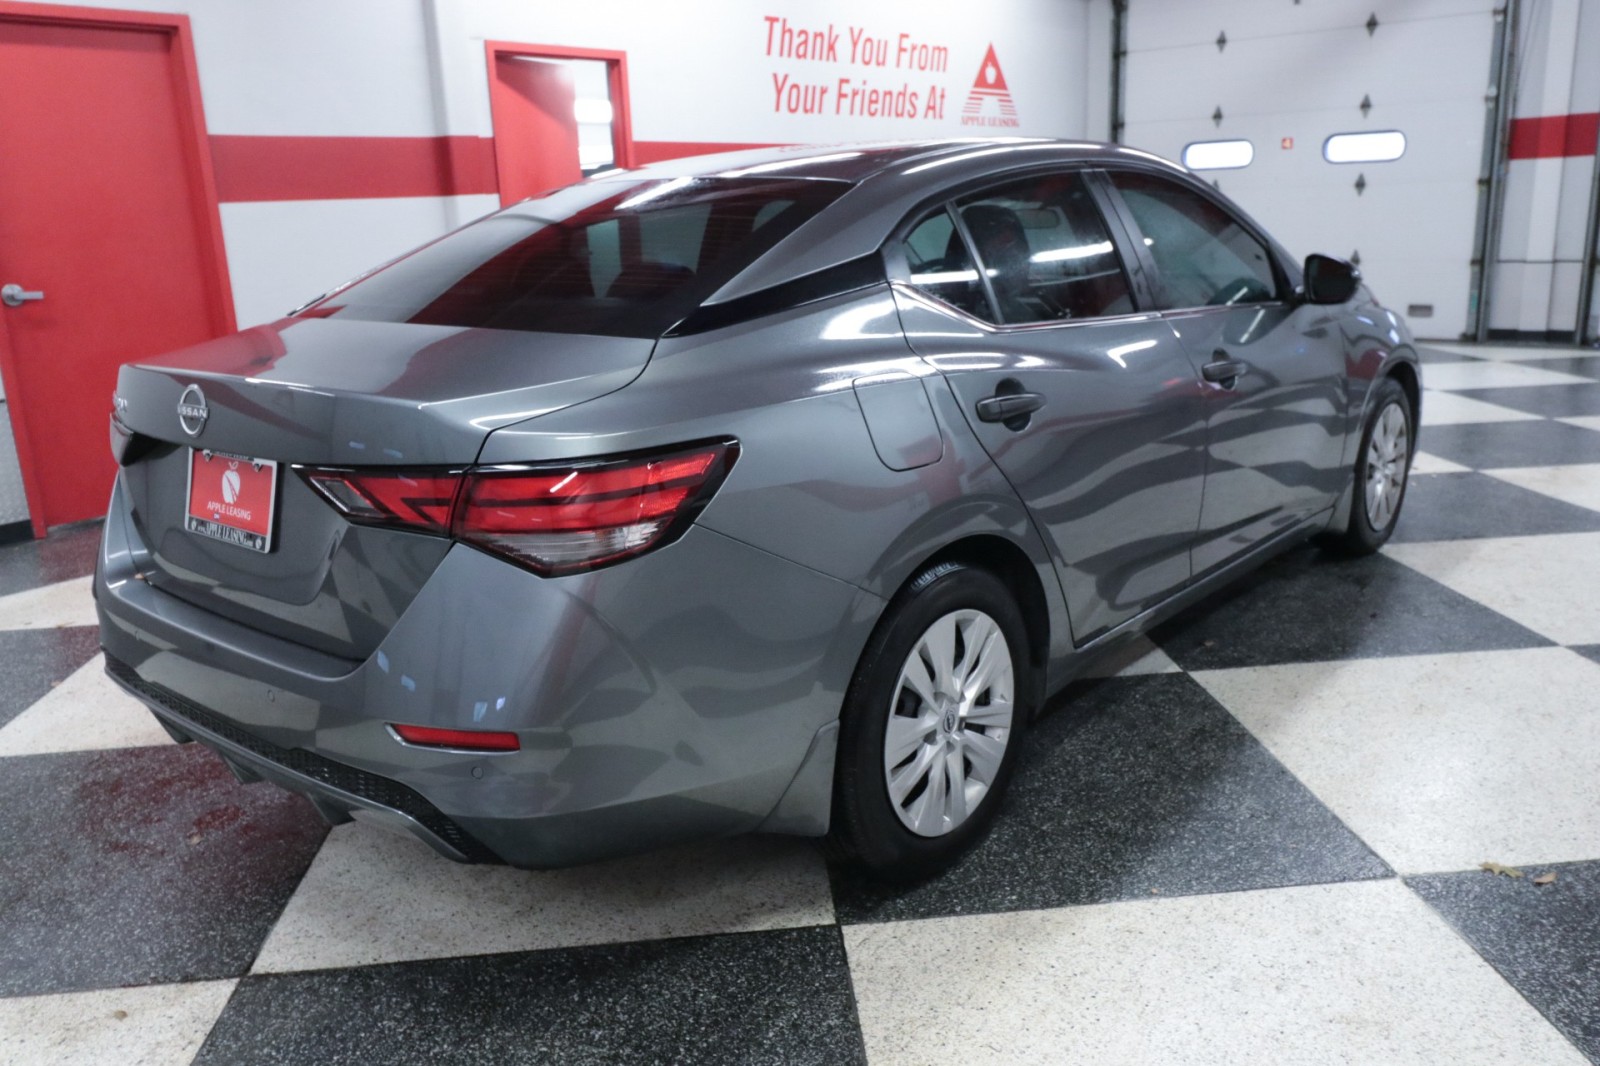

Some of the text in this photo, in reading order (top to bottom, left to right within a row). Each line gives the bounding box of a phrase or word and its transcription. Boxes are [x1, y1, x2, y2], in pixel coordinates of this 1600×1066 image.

[764, 15, 948, 73] Thank You From
[772, 73, 945, 120] Your Friends At
[960, 115, 1020, 128] APPLE LEASING
[207, 501, 226, 514] APPLE
[226, 506, 251, 520] LEASING
